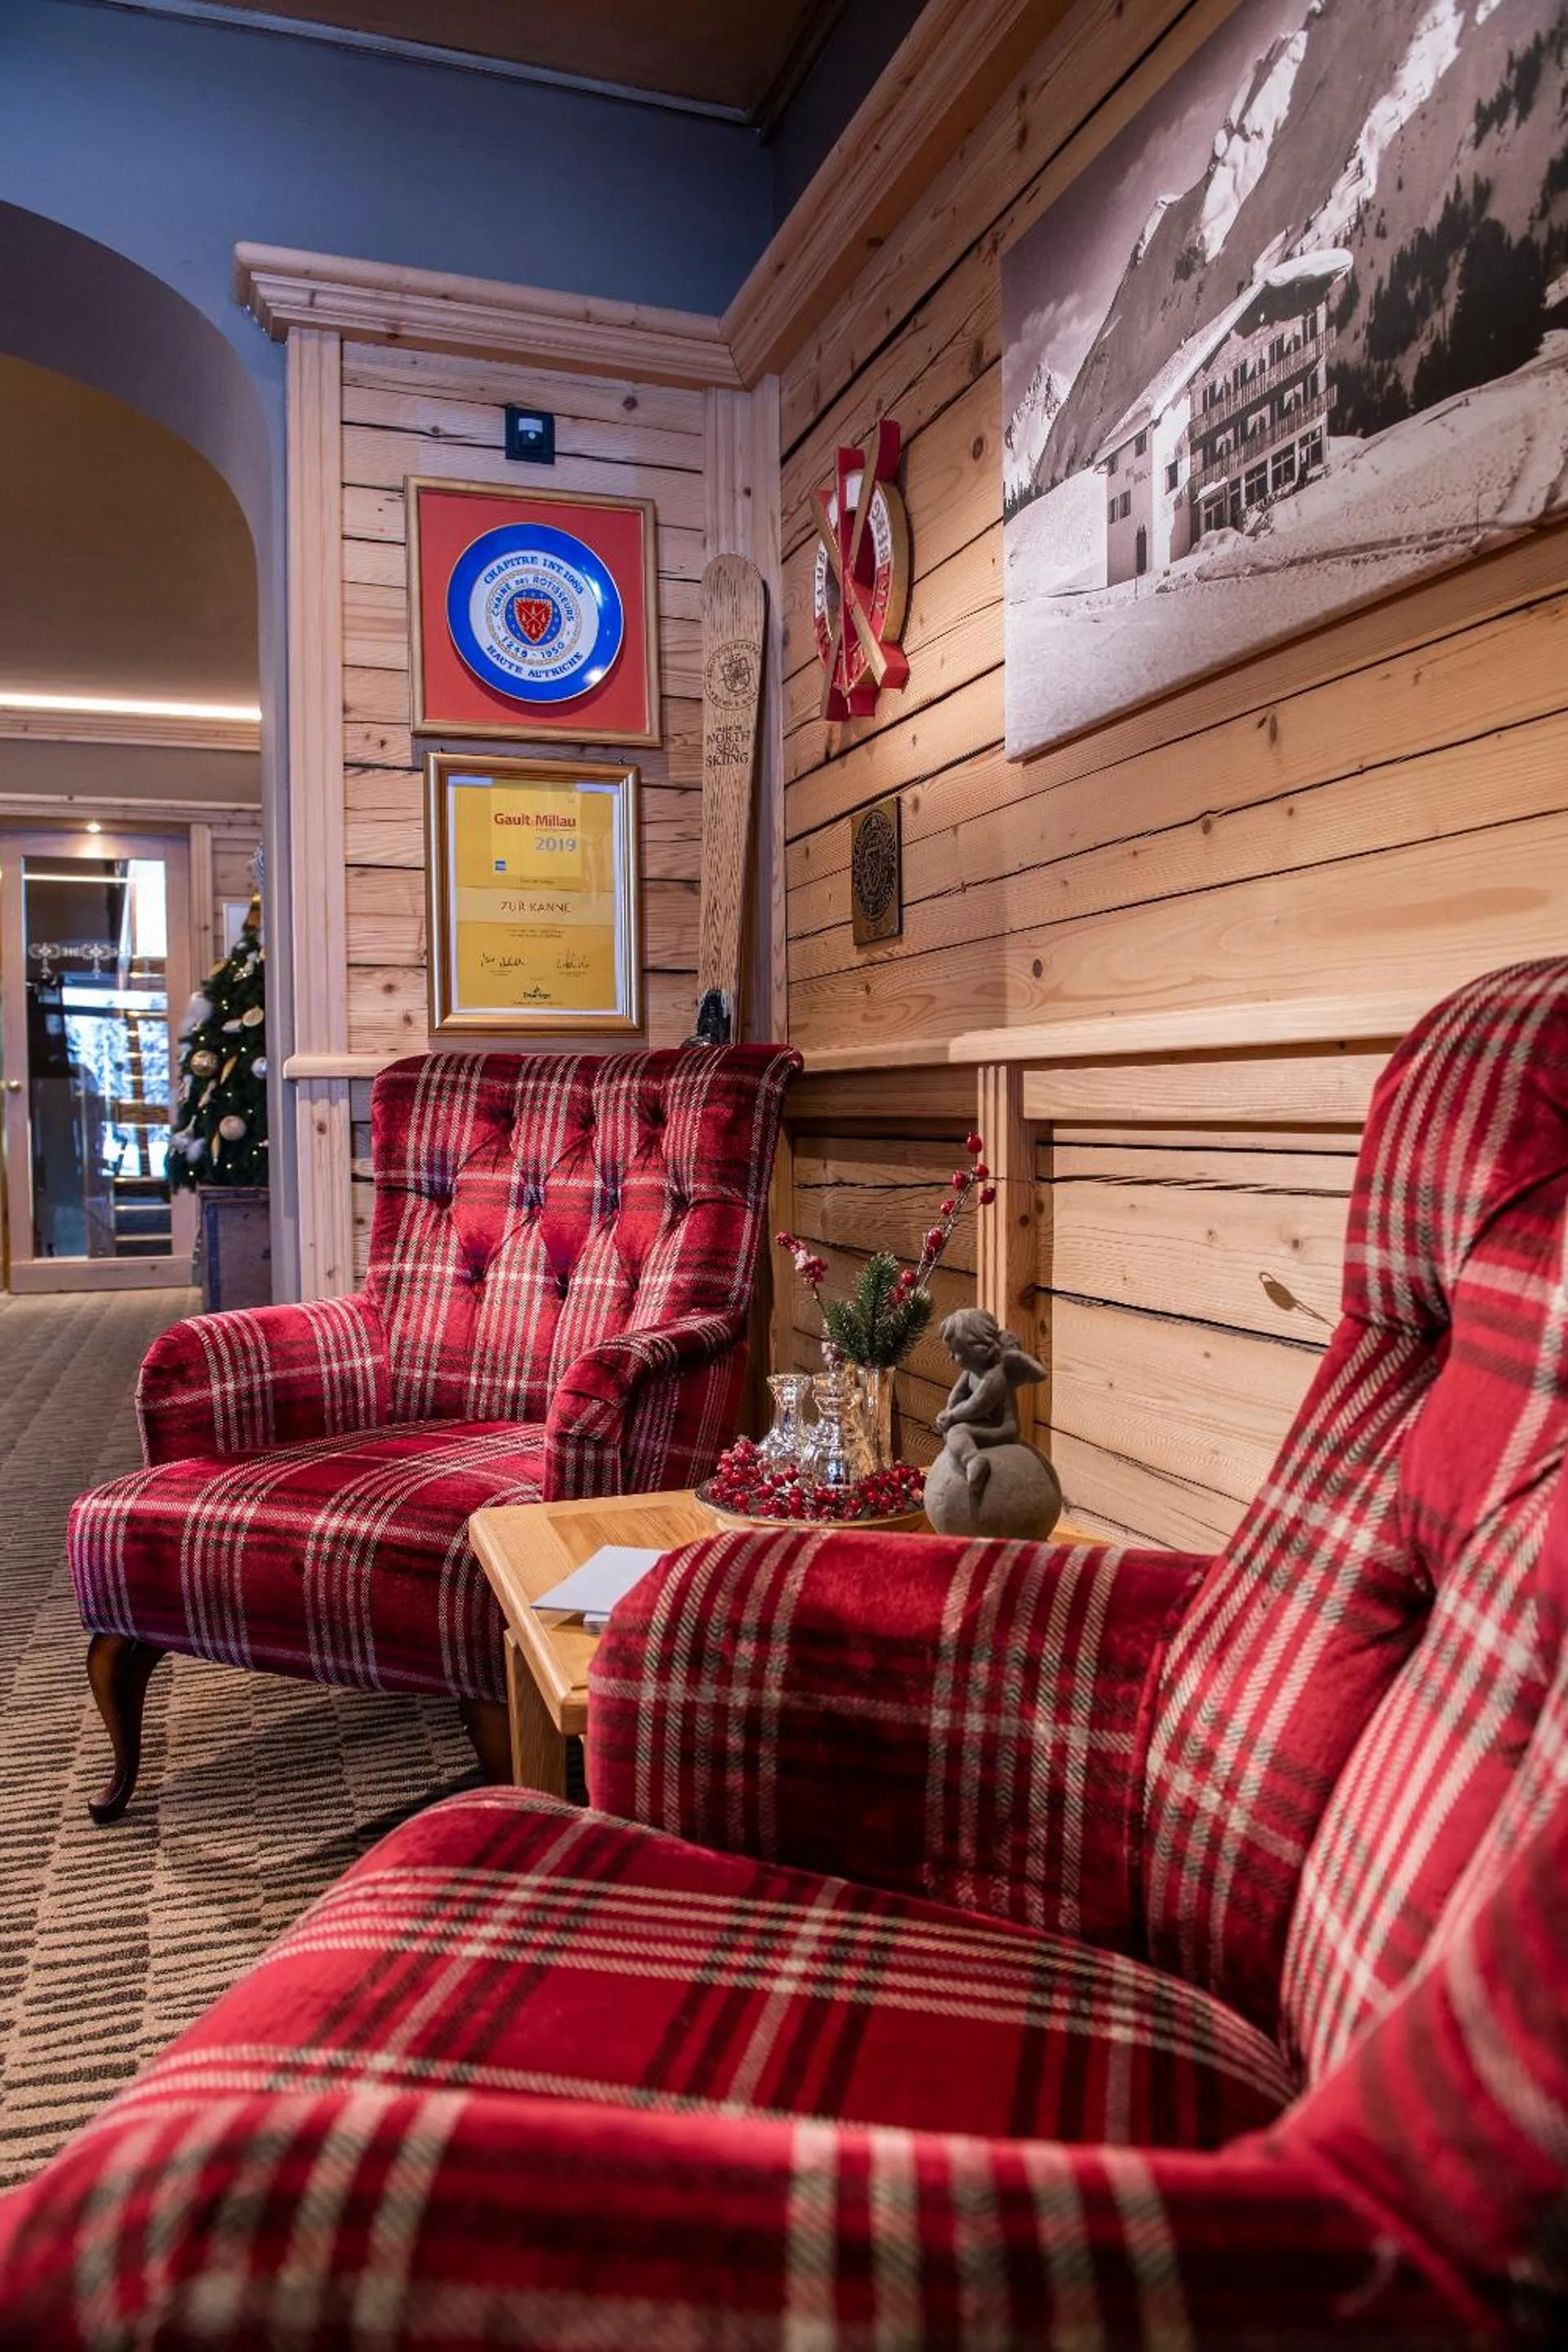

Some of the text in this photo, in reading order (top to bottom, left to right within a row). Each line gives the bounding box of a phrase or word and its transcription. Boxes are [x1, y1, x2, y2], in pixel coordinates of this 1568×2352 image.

[483, 556, 539, 585] CHAPITRE
[486, 644, 584, 679] HAUTE AUTRICHE
[706, 729, 751, 746] NORTH
[493, 813, 577, 828] Gault Millau
[533, 836, 577, 853] 2019
[501, 900, 572, 914] ZUR KANNE
